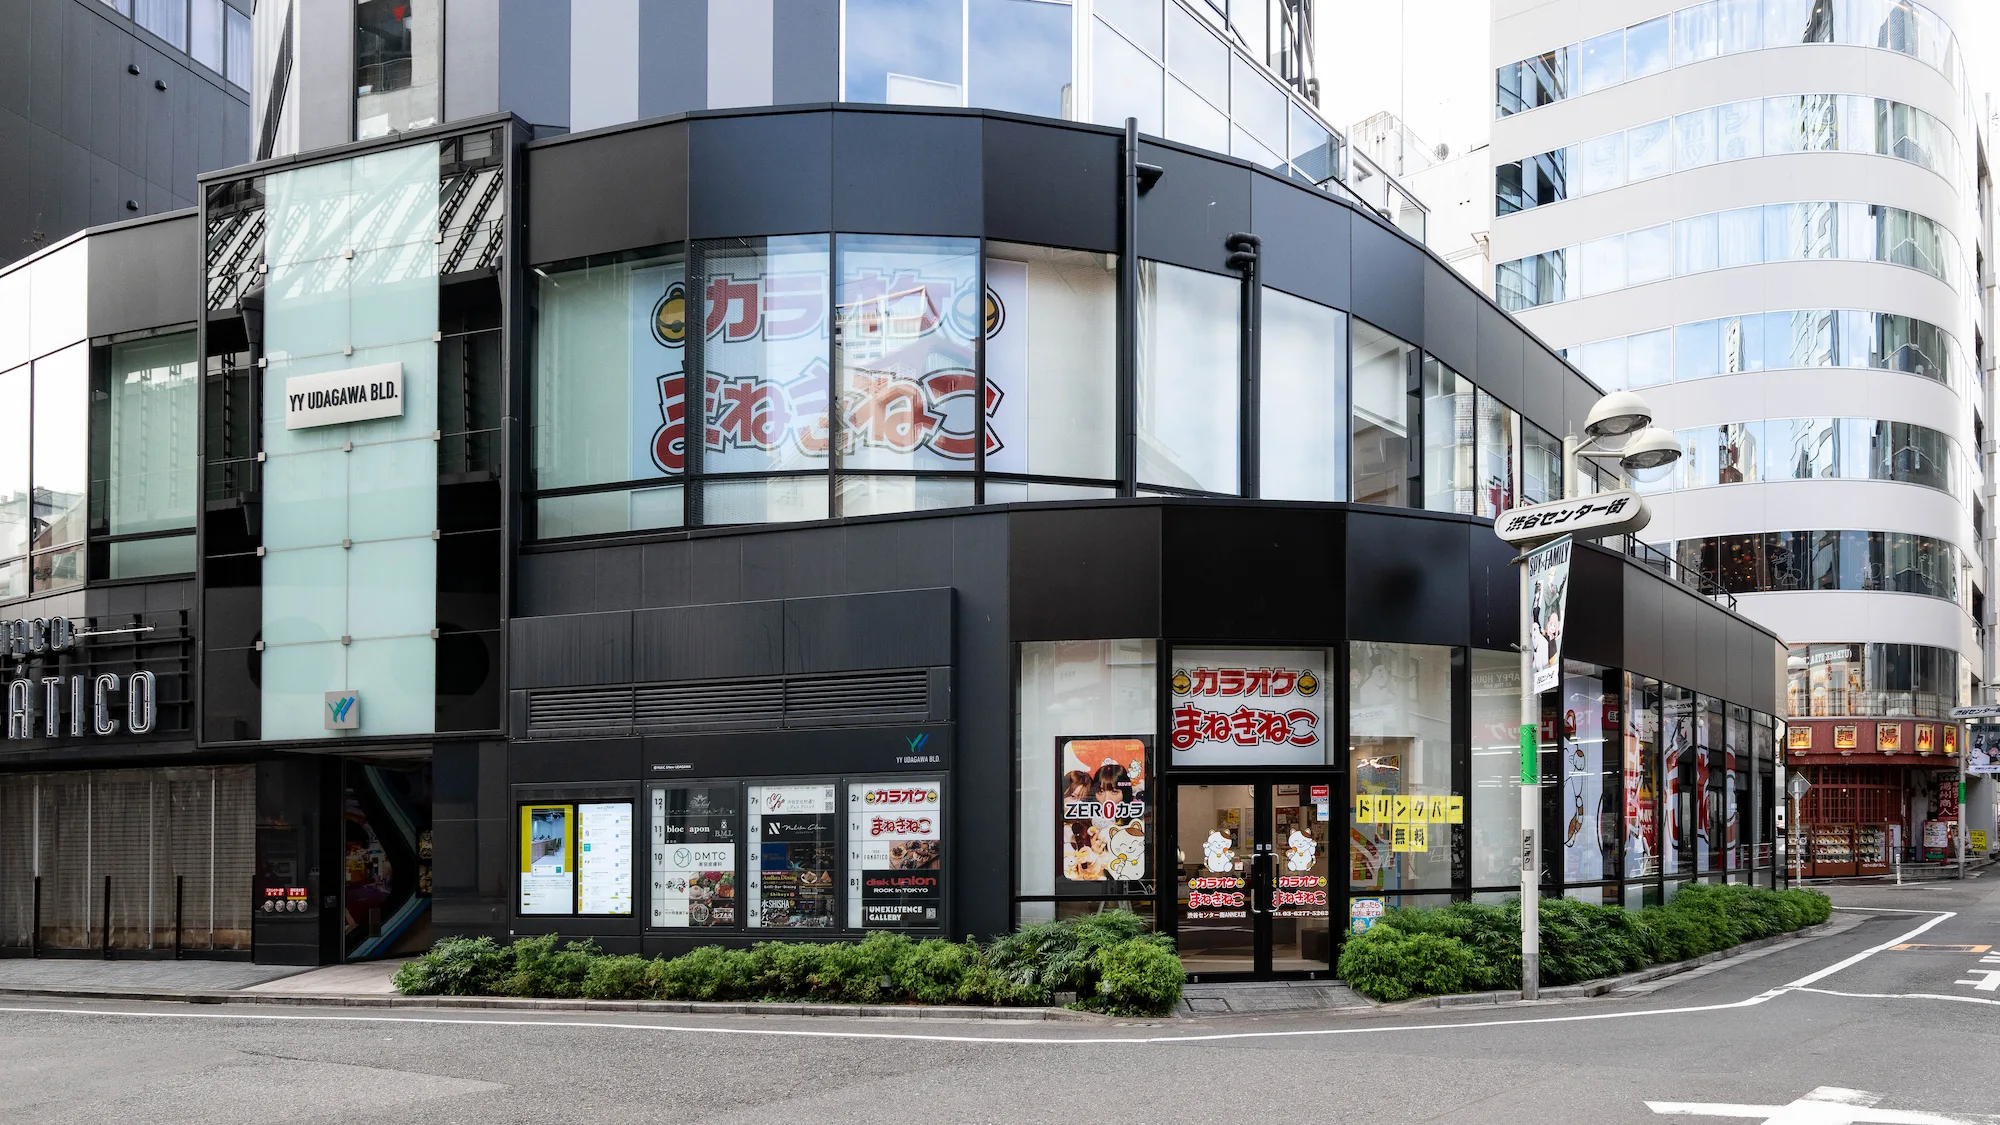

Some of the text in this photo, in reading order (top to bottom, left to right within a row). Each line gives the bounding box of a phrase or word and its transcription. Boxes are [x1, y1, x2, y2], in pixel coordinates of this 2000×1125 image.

[289, 381, 398, 412] YY UDAGAWA BLD.
[651, 357, 1004, 475] まねきねこ
[1505, 497, 1629, 532] 渋谷センター街
[1191, 667, 1299, 697] カラオケ
[0, 664, 157, 740] ÁTICO
[1172, 702, 1319, 751] まねきねこ
[904, 755, 928, 763] UDAGAWA
[875, 788, 927, 804] カラオケ
[1359, 799, 1461, 818] ドリンクバー
[666, 825, 684, 833] bloc
[870, 816, 932, 836] まねきねこ
[1395, 827, 1425, 846] 無料
[694, 852, 726, 860] DMTC
[890, 875, 936, 886] union
[1197, 877, 1237, 888] カラオケ
[1279, 876, 1318, 888] カラオケ
[769, 900, 790, 908] SHISHA
[1189, 891, 1244, 909] まねきねこ
[1272, 890, 1326, 907] まねきねこ
